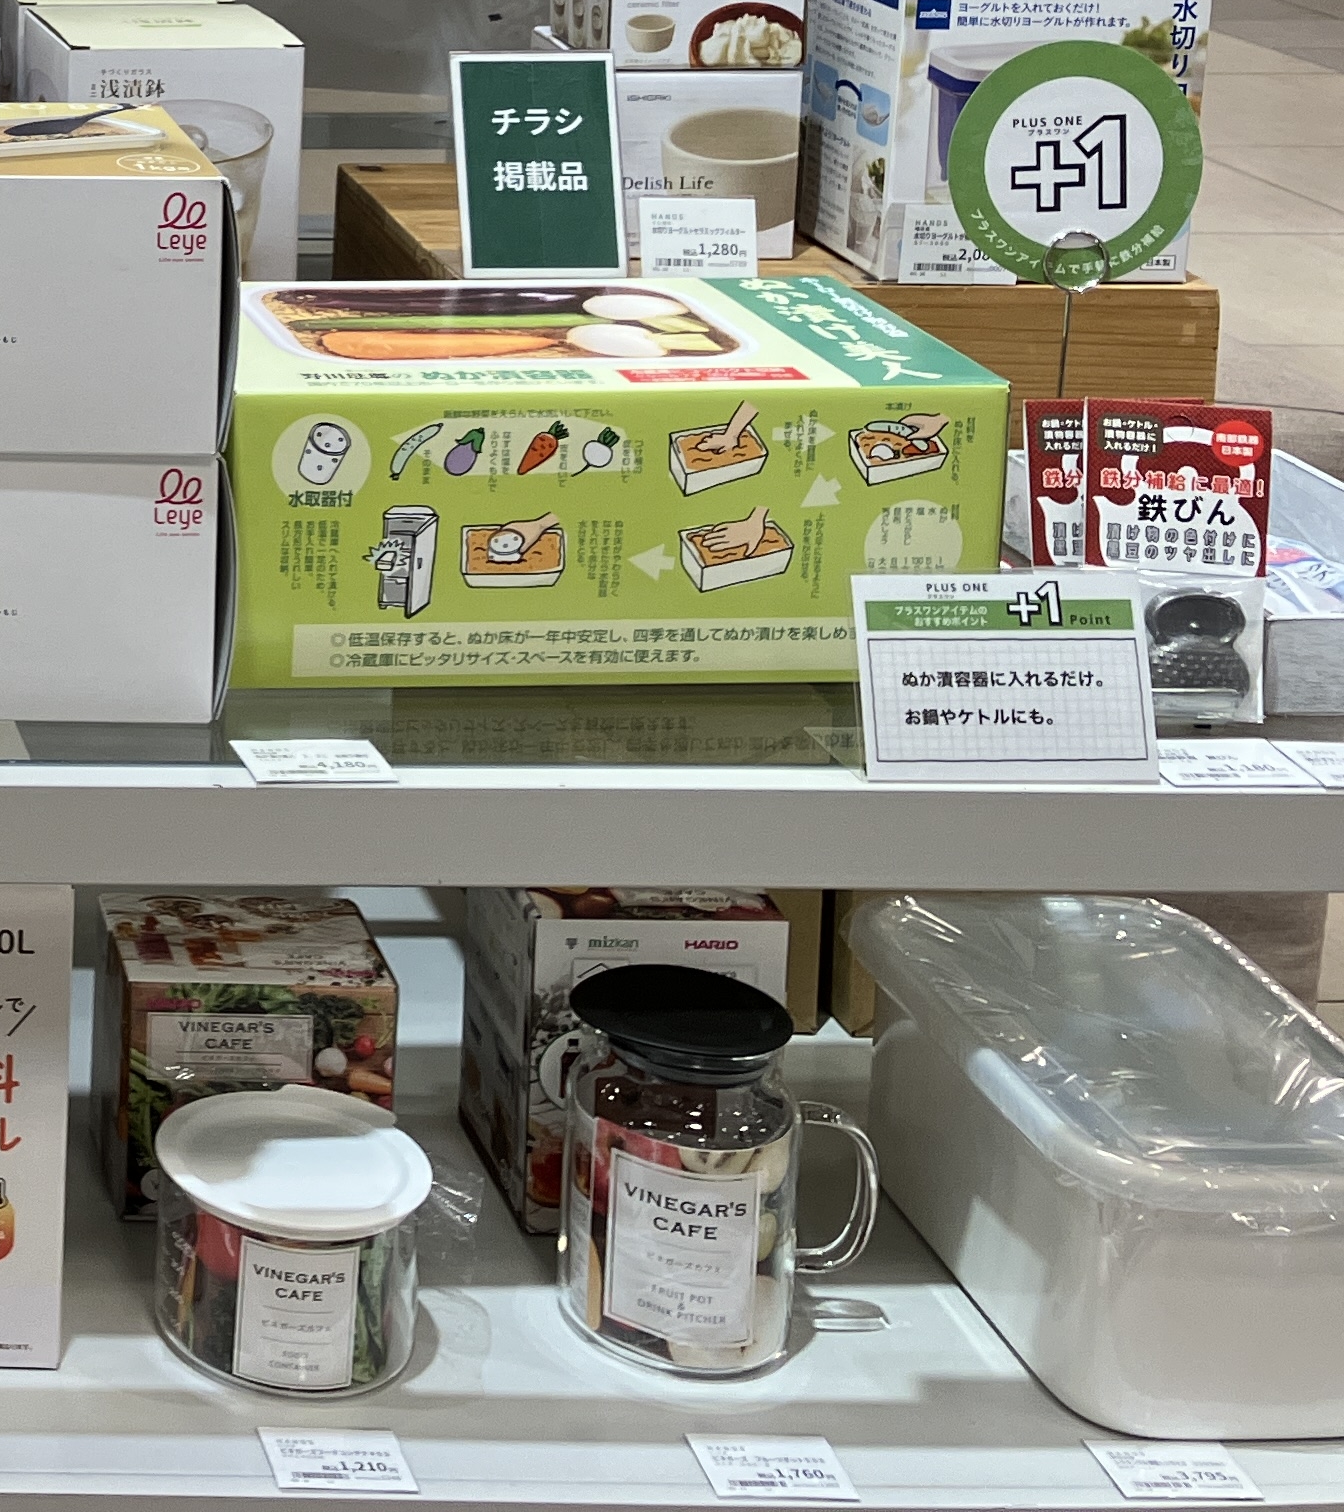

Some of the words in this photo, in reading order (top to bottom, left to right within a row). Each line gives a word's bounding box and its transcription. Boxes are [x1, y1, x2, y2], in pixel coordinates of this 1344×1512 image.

[958, 2, 1100, 13] ヨーグルトを入れておくだけ!
[957, 15, 1131, 28] 簡単に水切りヨーグルトが作れます。
[100, 79, 166, 98] 浅漬鉢
[491, 108, 583, 136] チラシ
[1013, 117, 1047, 128] PLUS
[1054, 116, 1083, 126] ONE
[1011, 114, 1127, 212] +1
[493, 161, 588, 191] 掲載品
[622, 176, 673, 190] Delish
[680, 176, 714, 189] Life
[157, 232, 207, 256] Leye
[1101, 471, 1264, 498] 鉄分補給に最適!
[289, 491, 353, 507] 水取器付
[1138, 494, 1235, 524] 鉄びん
[154, 507, 203, 531] Leye
[926, 584, 958, 592] PLUS
[962, 583, 988, 592] ONE
[901, 670, 1104, 688] ぬか漬容器に入れるだけ。
[901, 707, 1055, 726] お鍋やケトルにも。
[588, 936, 640, 949] mizkan
[684, 939, 739, 950] HARIO
[178, 1020, 275, 1035] VINEGAR'S
[204, 1038, 252, 1051] CAFE
[624, 1181, 748, 1219] VINEGAR'S
[653, 1216, 718, 1241] CAFE
[253, 1263, 346, 1284] VINEGAR'S
[275, 1287, 323, 1302] CAFE
